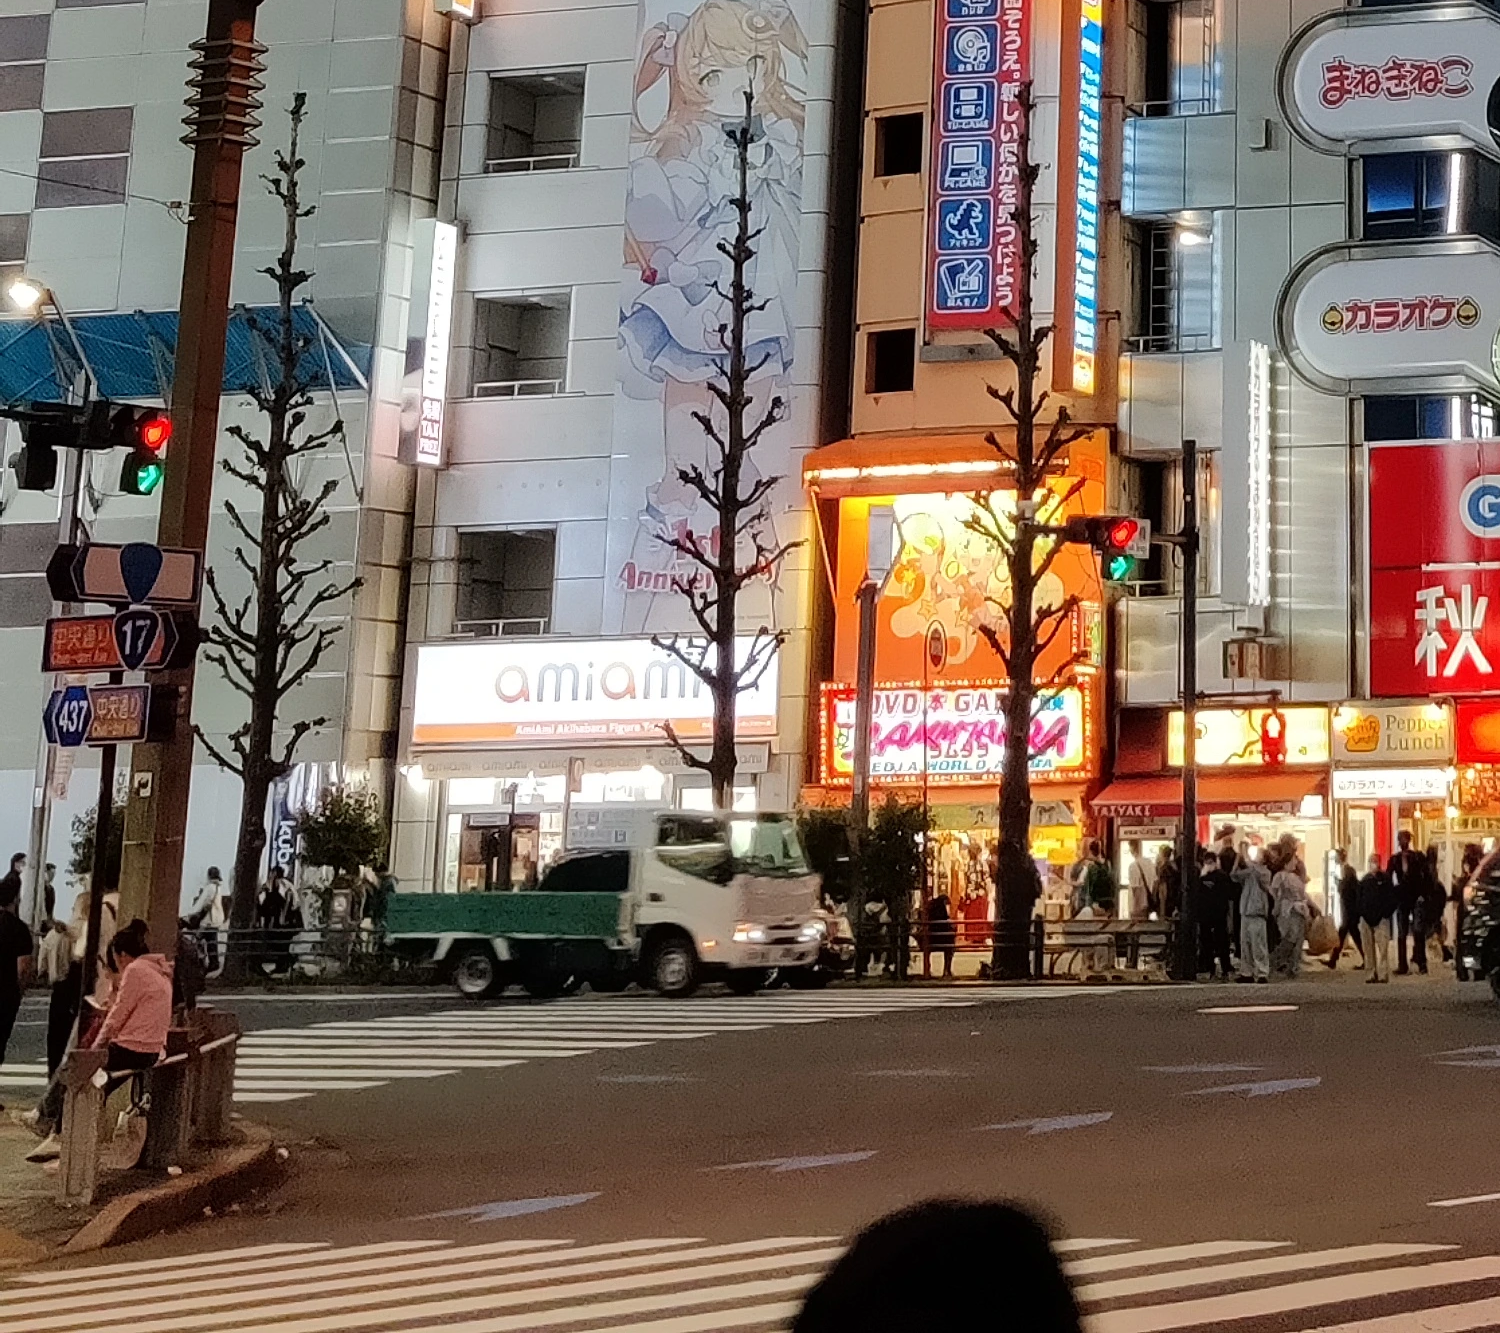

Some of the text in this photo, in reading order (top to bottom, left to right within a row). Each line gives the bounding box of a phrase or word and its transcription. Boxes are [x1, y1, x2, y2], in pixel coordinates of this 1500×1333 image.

[1318, 55, 1474, 108] まねきねこ
[1343, 298, 1458, 332] カラオケ
[121, 618, 153, 658] 17
[58, 699, 89, 734] 437
[96, 694, 142, 720] 中央通り
[514, 723, 555, 736] AmiAmi
[556, 722, 608, 735] Akihabara
[608, 722, 642, 736] Figure
[1386, 714, 1446, 733] Pepper
[1385, 733, 1446, 752] Lunch
[871, 760, 920, 773] EDIA
